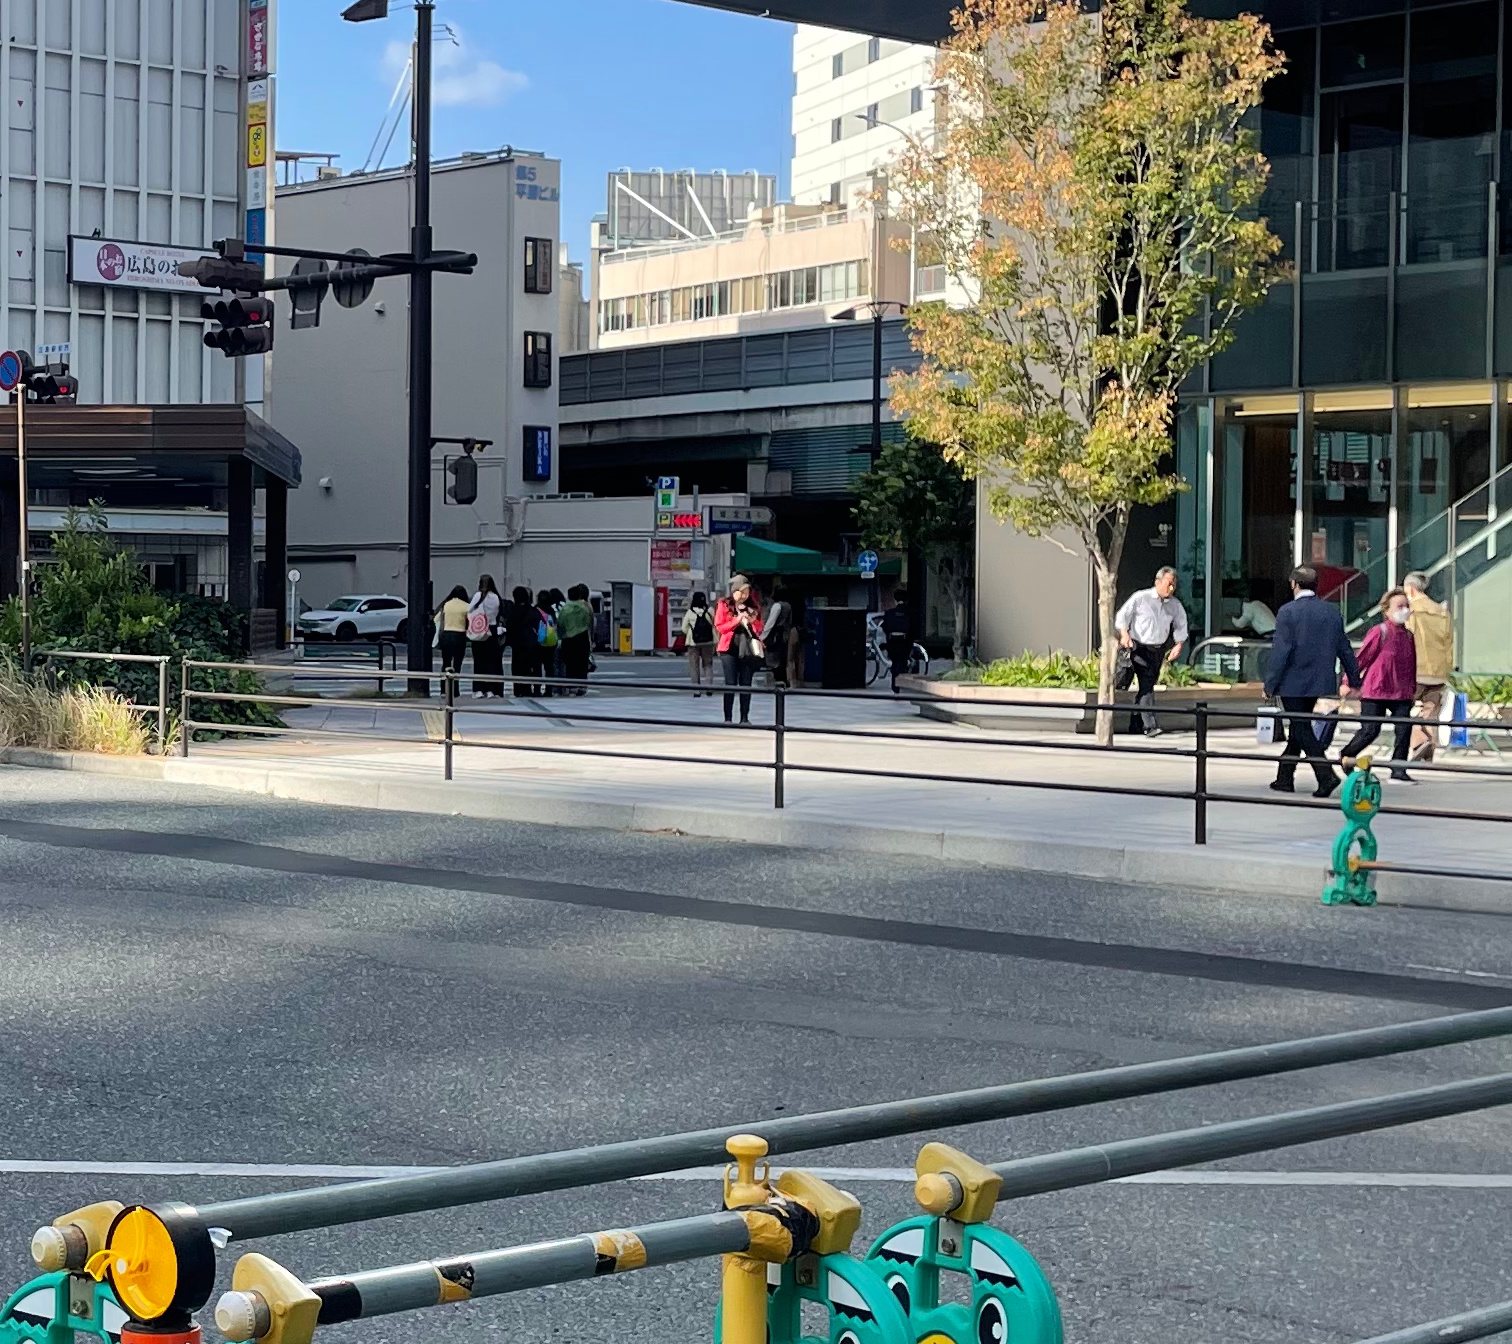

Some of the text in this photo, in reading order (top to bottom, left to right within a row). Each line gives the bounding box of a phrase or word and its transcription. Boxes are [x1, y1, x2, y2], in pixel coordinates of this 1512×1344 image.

[127, 256, 179, 276] 広島の
[662, 478, 671, 489] P
